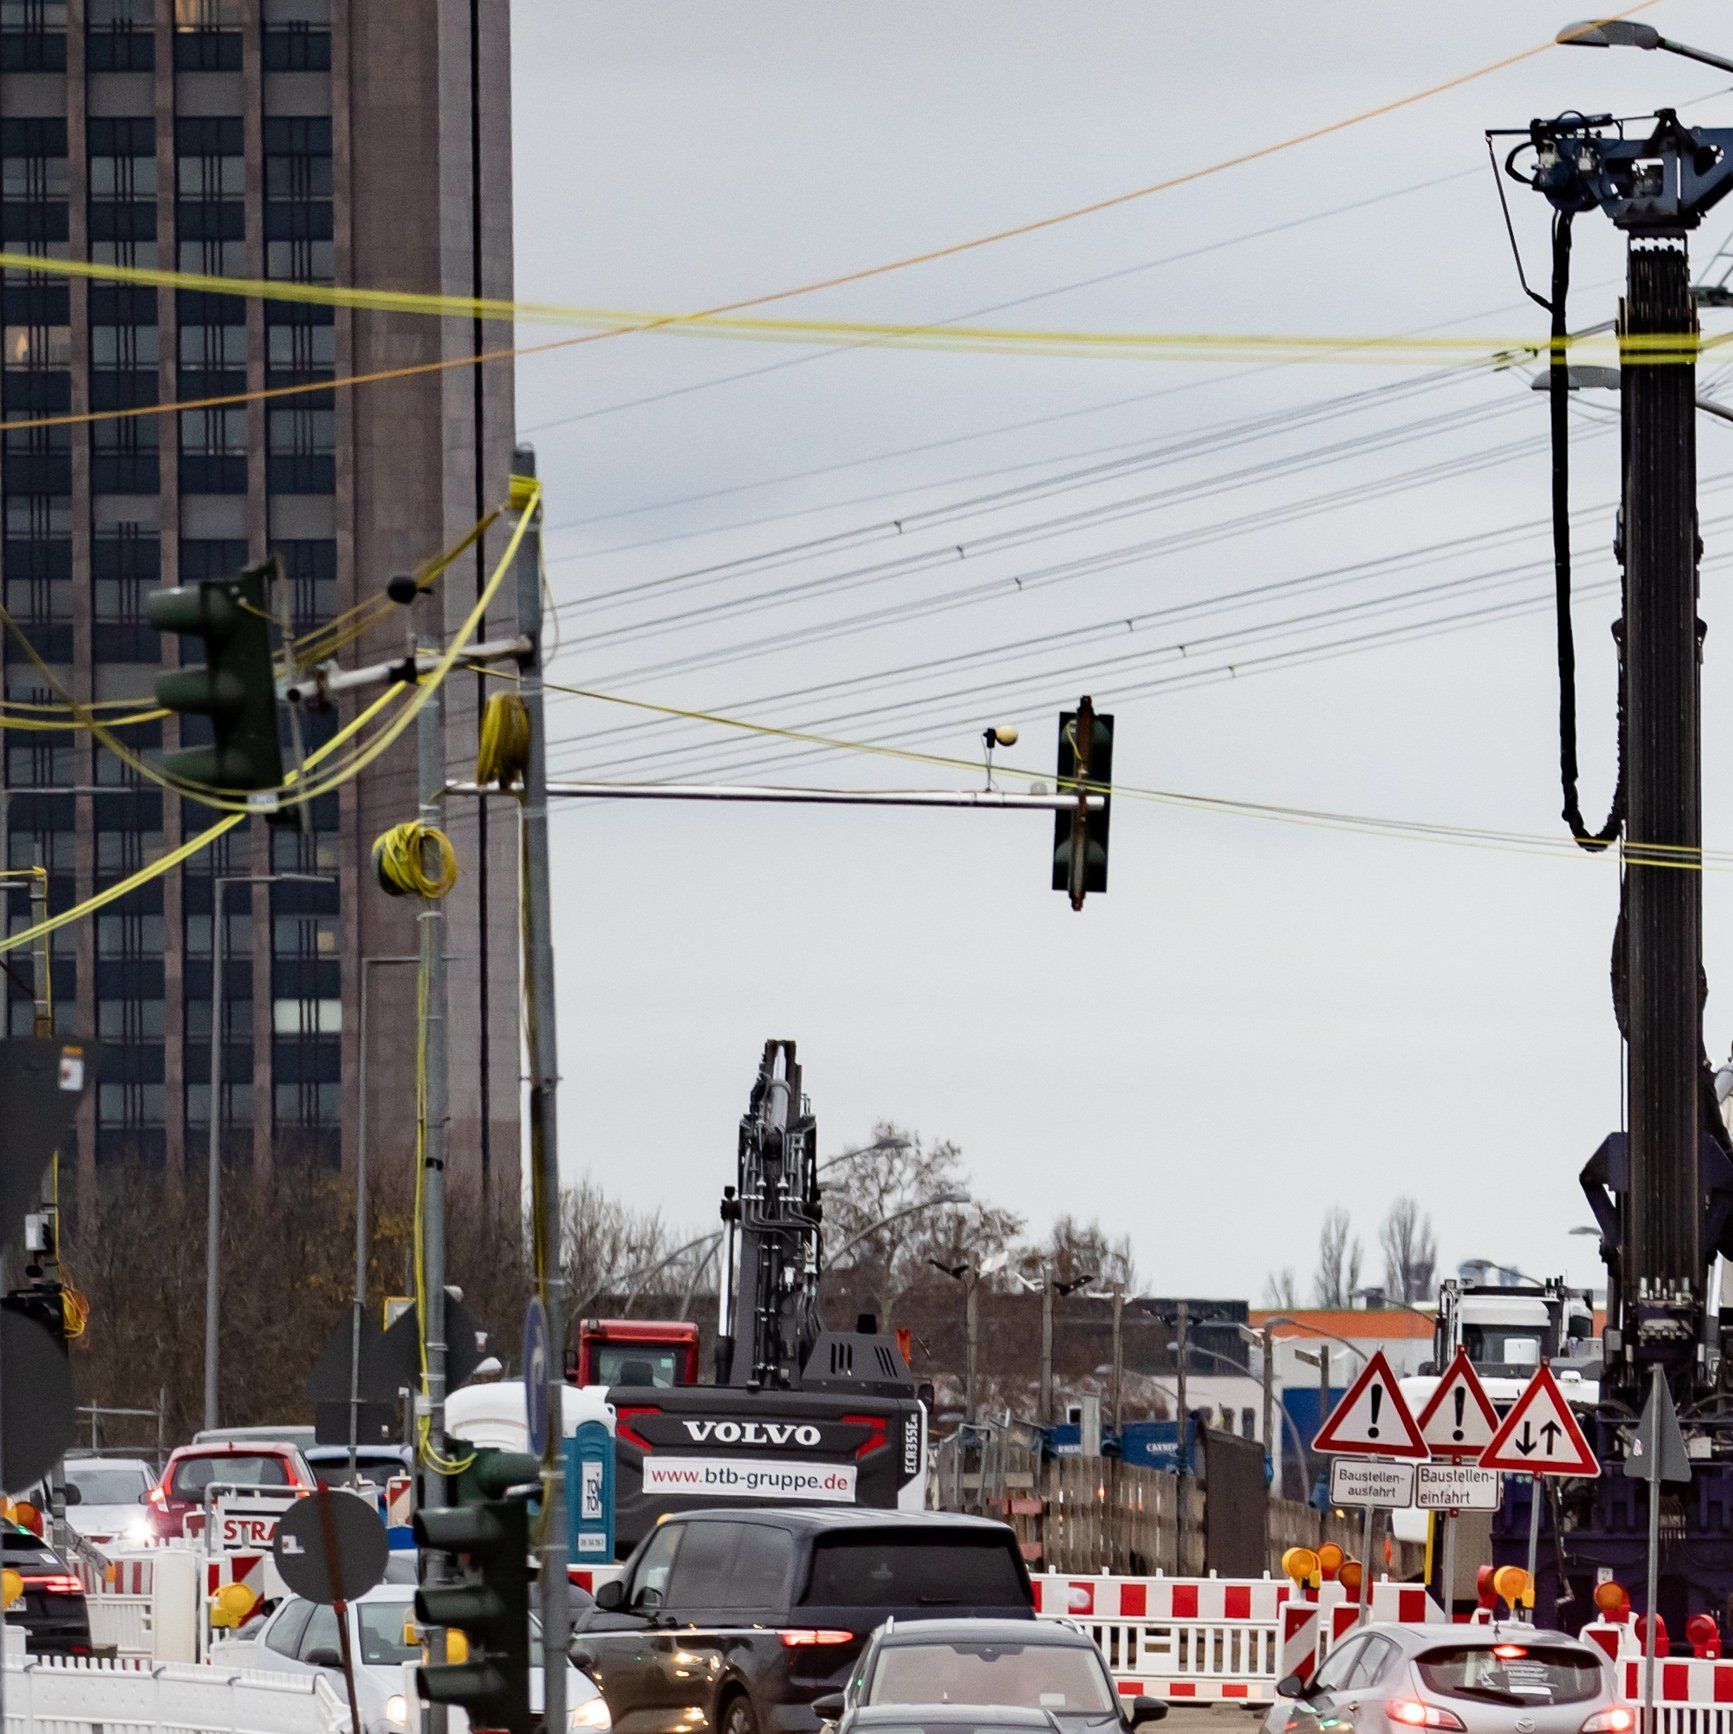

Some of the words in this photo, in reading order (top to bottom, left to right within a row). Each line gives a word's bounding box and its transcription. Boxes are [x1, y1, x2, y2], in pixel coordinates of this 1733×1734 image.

[683, 1420, 821, 1446] VOLVO
[651, 1467, 848, 1491] www.btb-gruppe.de
[1338, 1468, 1405, 1484] Baustellen-
[1420, 1467, 1495, 1483] Baustellen-
[1347, 1486, 1396, 1498] ausfahrt
[1420, 1490, 1471, 1505] einfahrt
